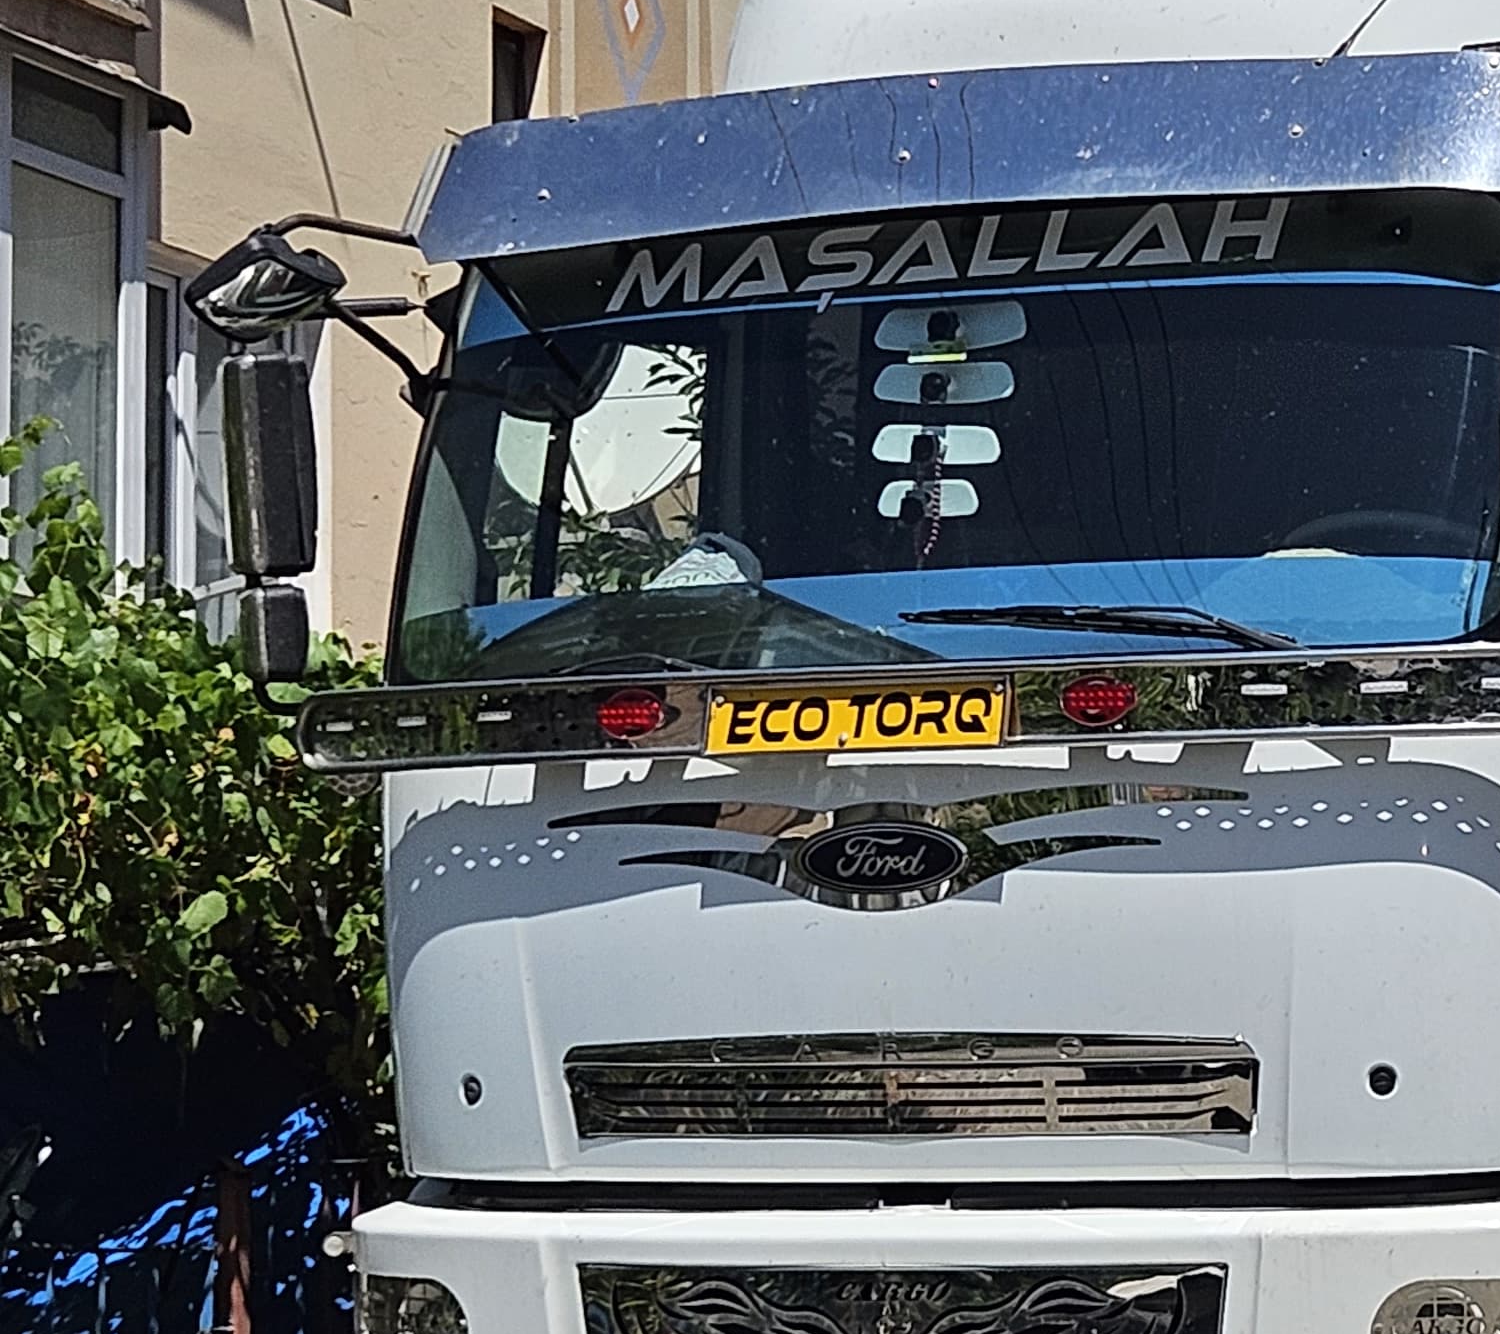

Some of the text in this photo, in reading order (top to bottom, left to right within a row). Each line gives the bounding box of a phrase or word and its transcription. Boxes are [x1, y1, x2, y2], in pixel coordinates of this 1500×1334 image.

[605, 197, 1291, 314] MAŞALLAH
[726, 687, 993, 745] ECO TORQ
[836, 835, 927, 877] Ford
